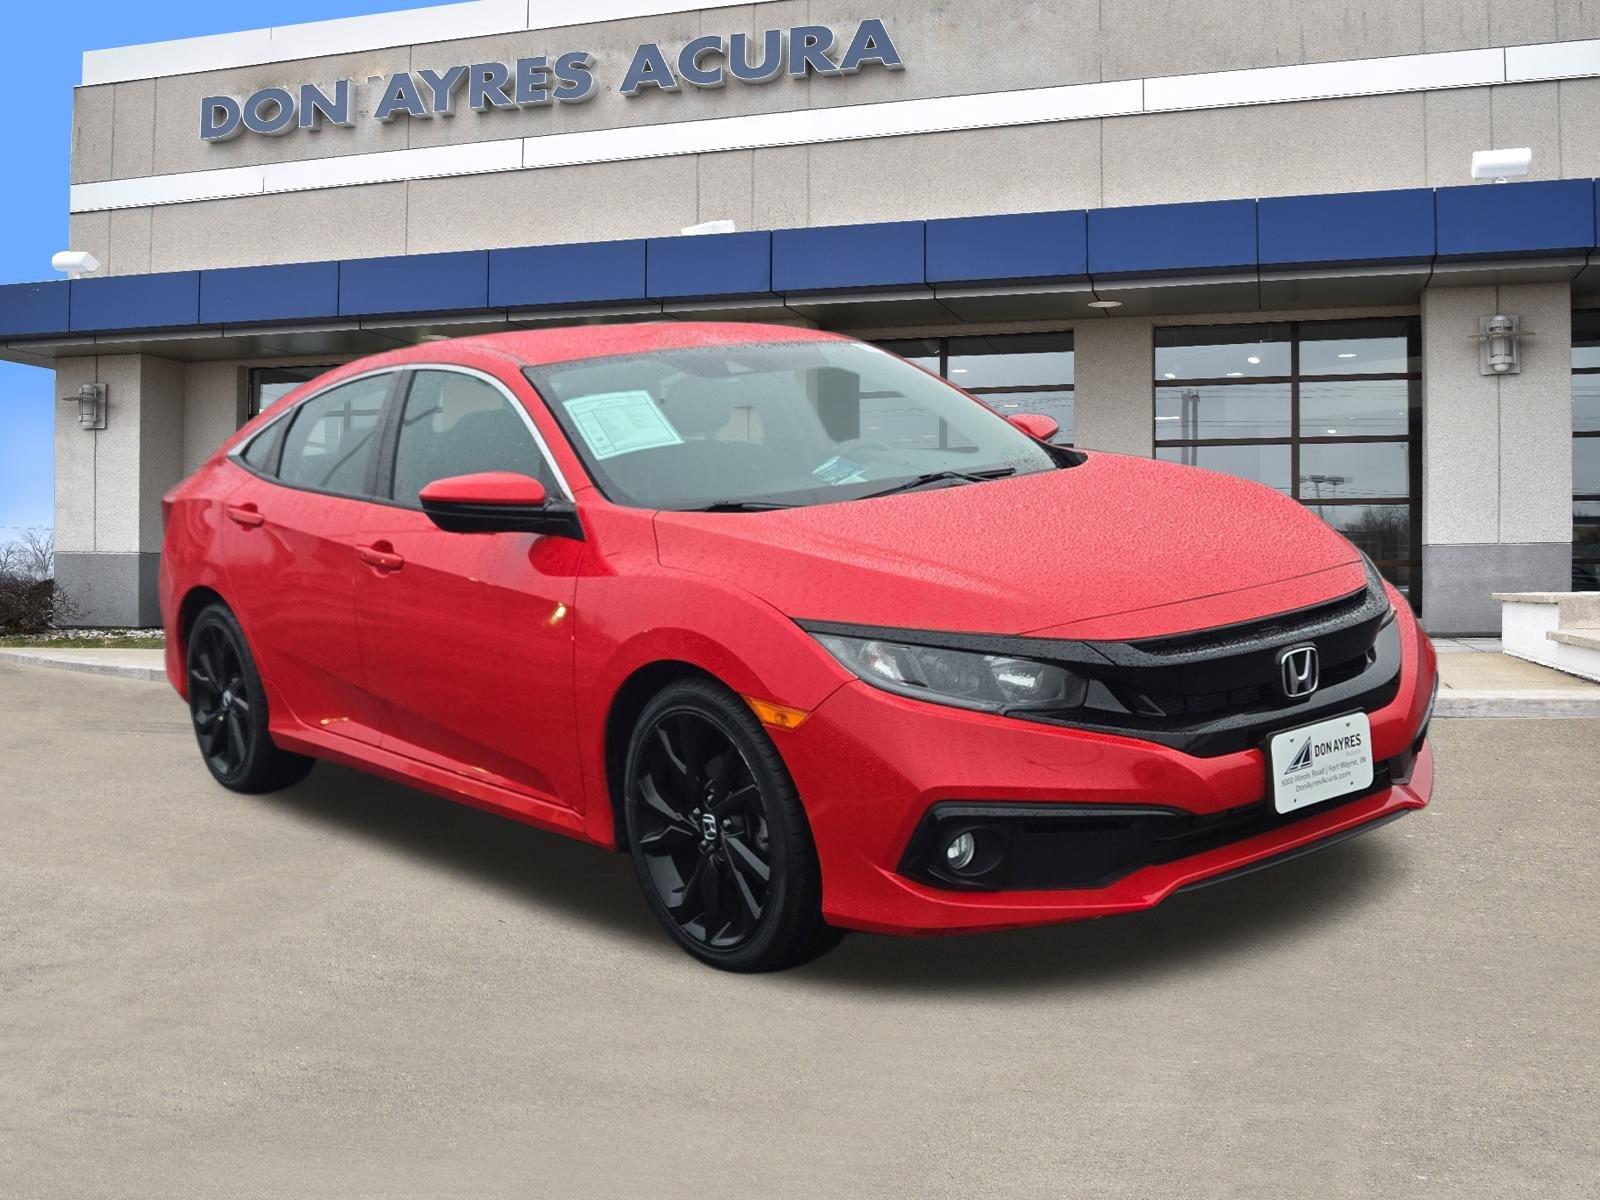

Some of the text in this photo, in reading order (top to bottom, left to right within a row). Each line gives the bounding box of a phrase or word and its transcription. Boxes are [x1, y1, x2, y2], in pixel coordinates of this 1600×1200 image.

[199, 17, 906, 142] DON AYRES ACURA
[1314, 733, 1362, 757] DON AYRES
[1311, 768, 1325, 776] Road
[1328, 764, 1340, 772] Fort
